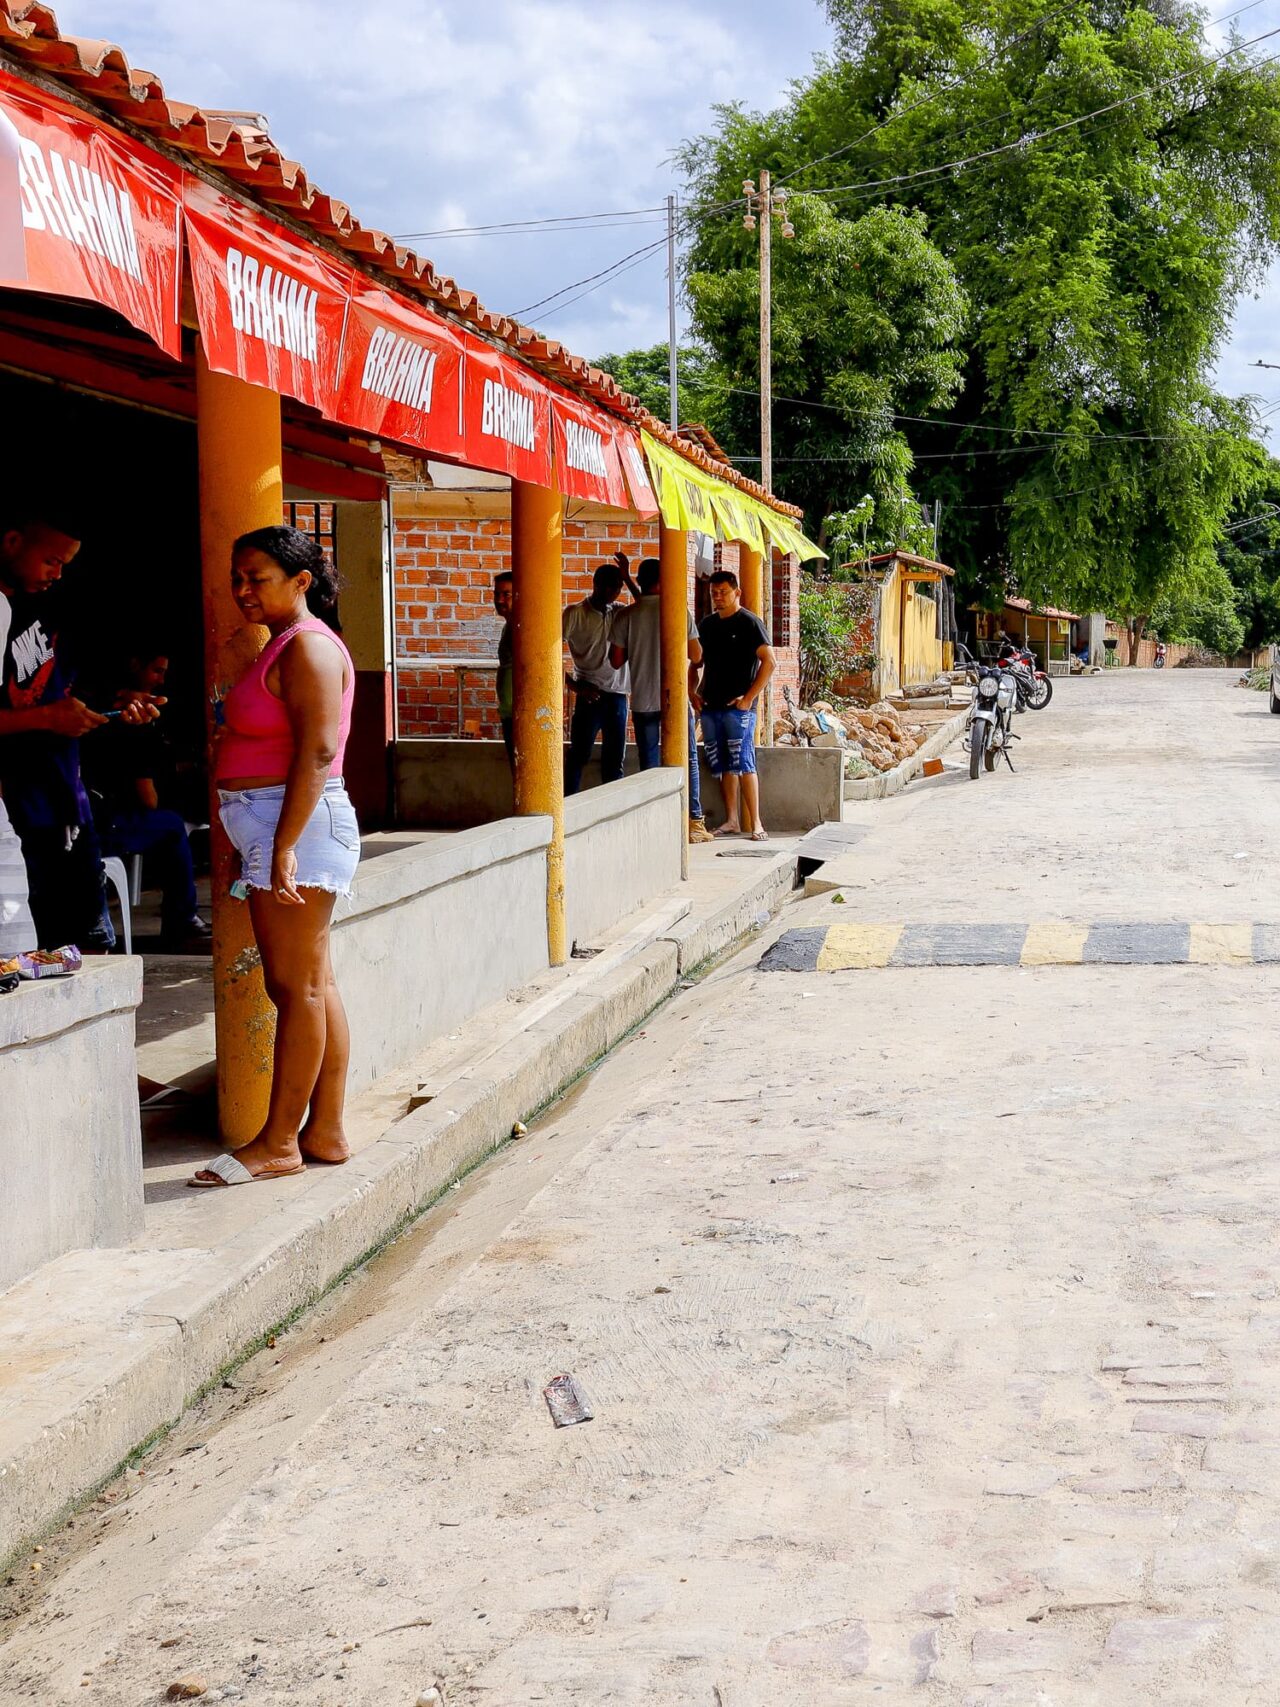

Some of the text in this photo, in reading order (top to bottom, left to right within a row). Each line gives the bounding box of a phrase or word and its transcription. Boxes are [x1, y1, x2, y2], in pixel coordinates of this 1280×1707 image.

[19, 136, 144, 286] BRAHMA
[226, 247, 319, 365] BRAHMA
[361, 325, 438, 413] BRAHMA
[481, 378, 536, 452] BRAHMA
[566, 418, 609, 479] BRAHMA
